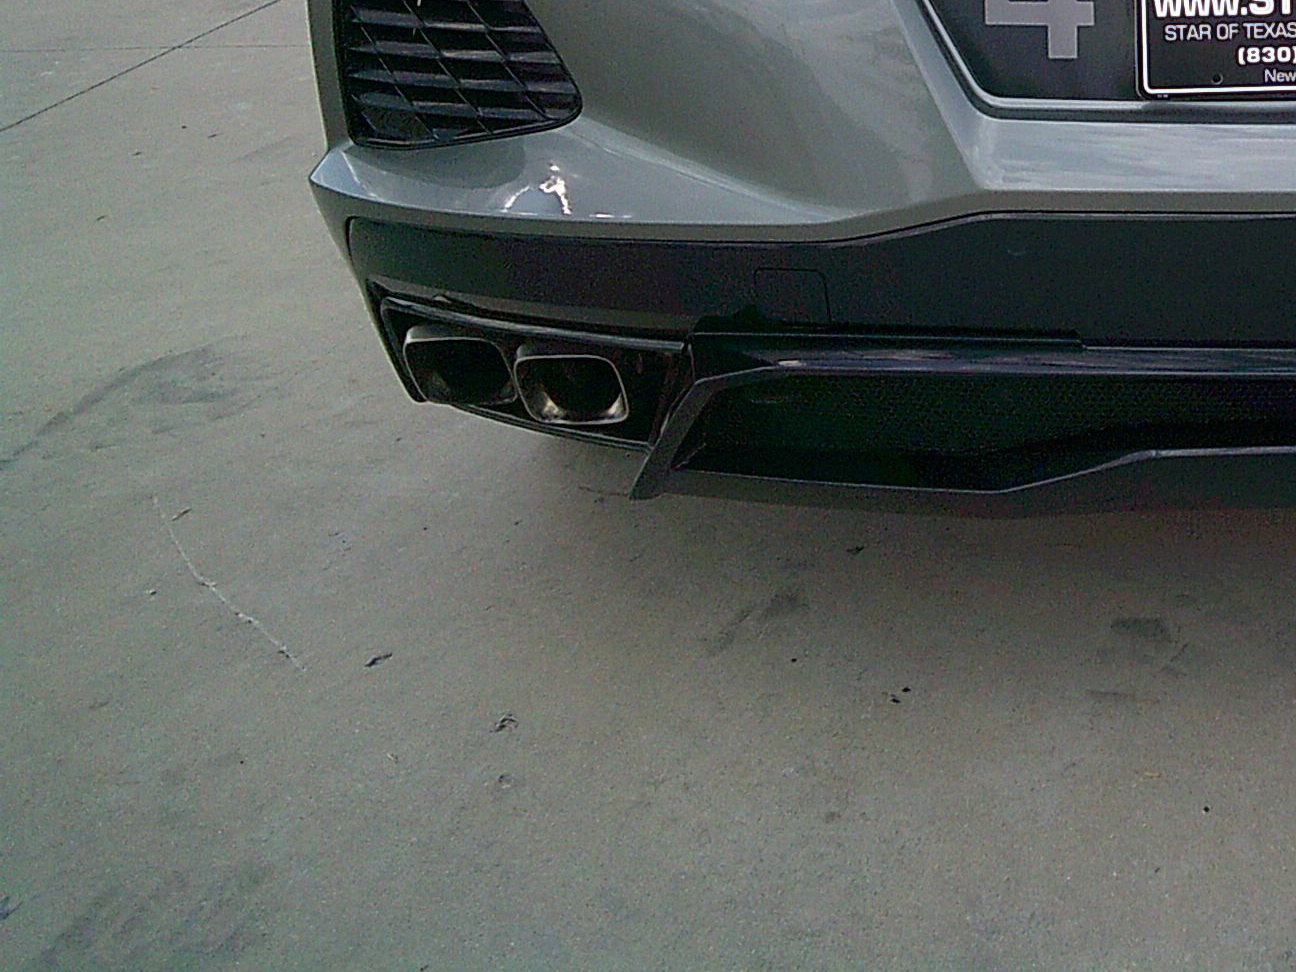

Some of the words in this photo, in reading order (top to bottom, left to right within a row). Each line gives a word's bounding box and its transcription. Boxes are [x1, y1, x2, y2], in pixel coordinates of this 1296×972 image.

[1164, 24, 1212, 41] STAR
[1216, 23, 1239, 40] OF
[1264, 68, 1296, 83] New
